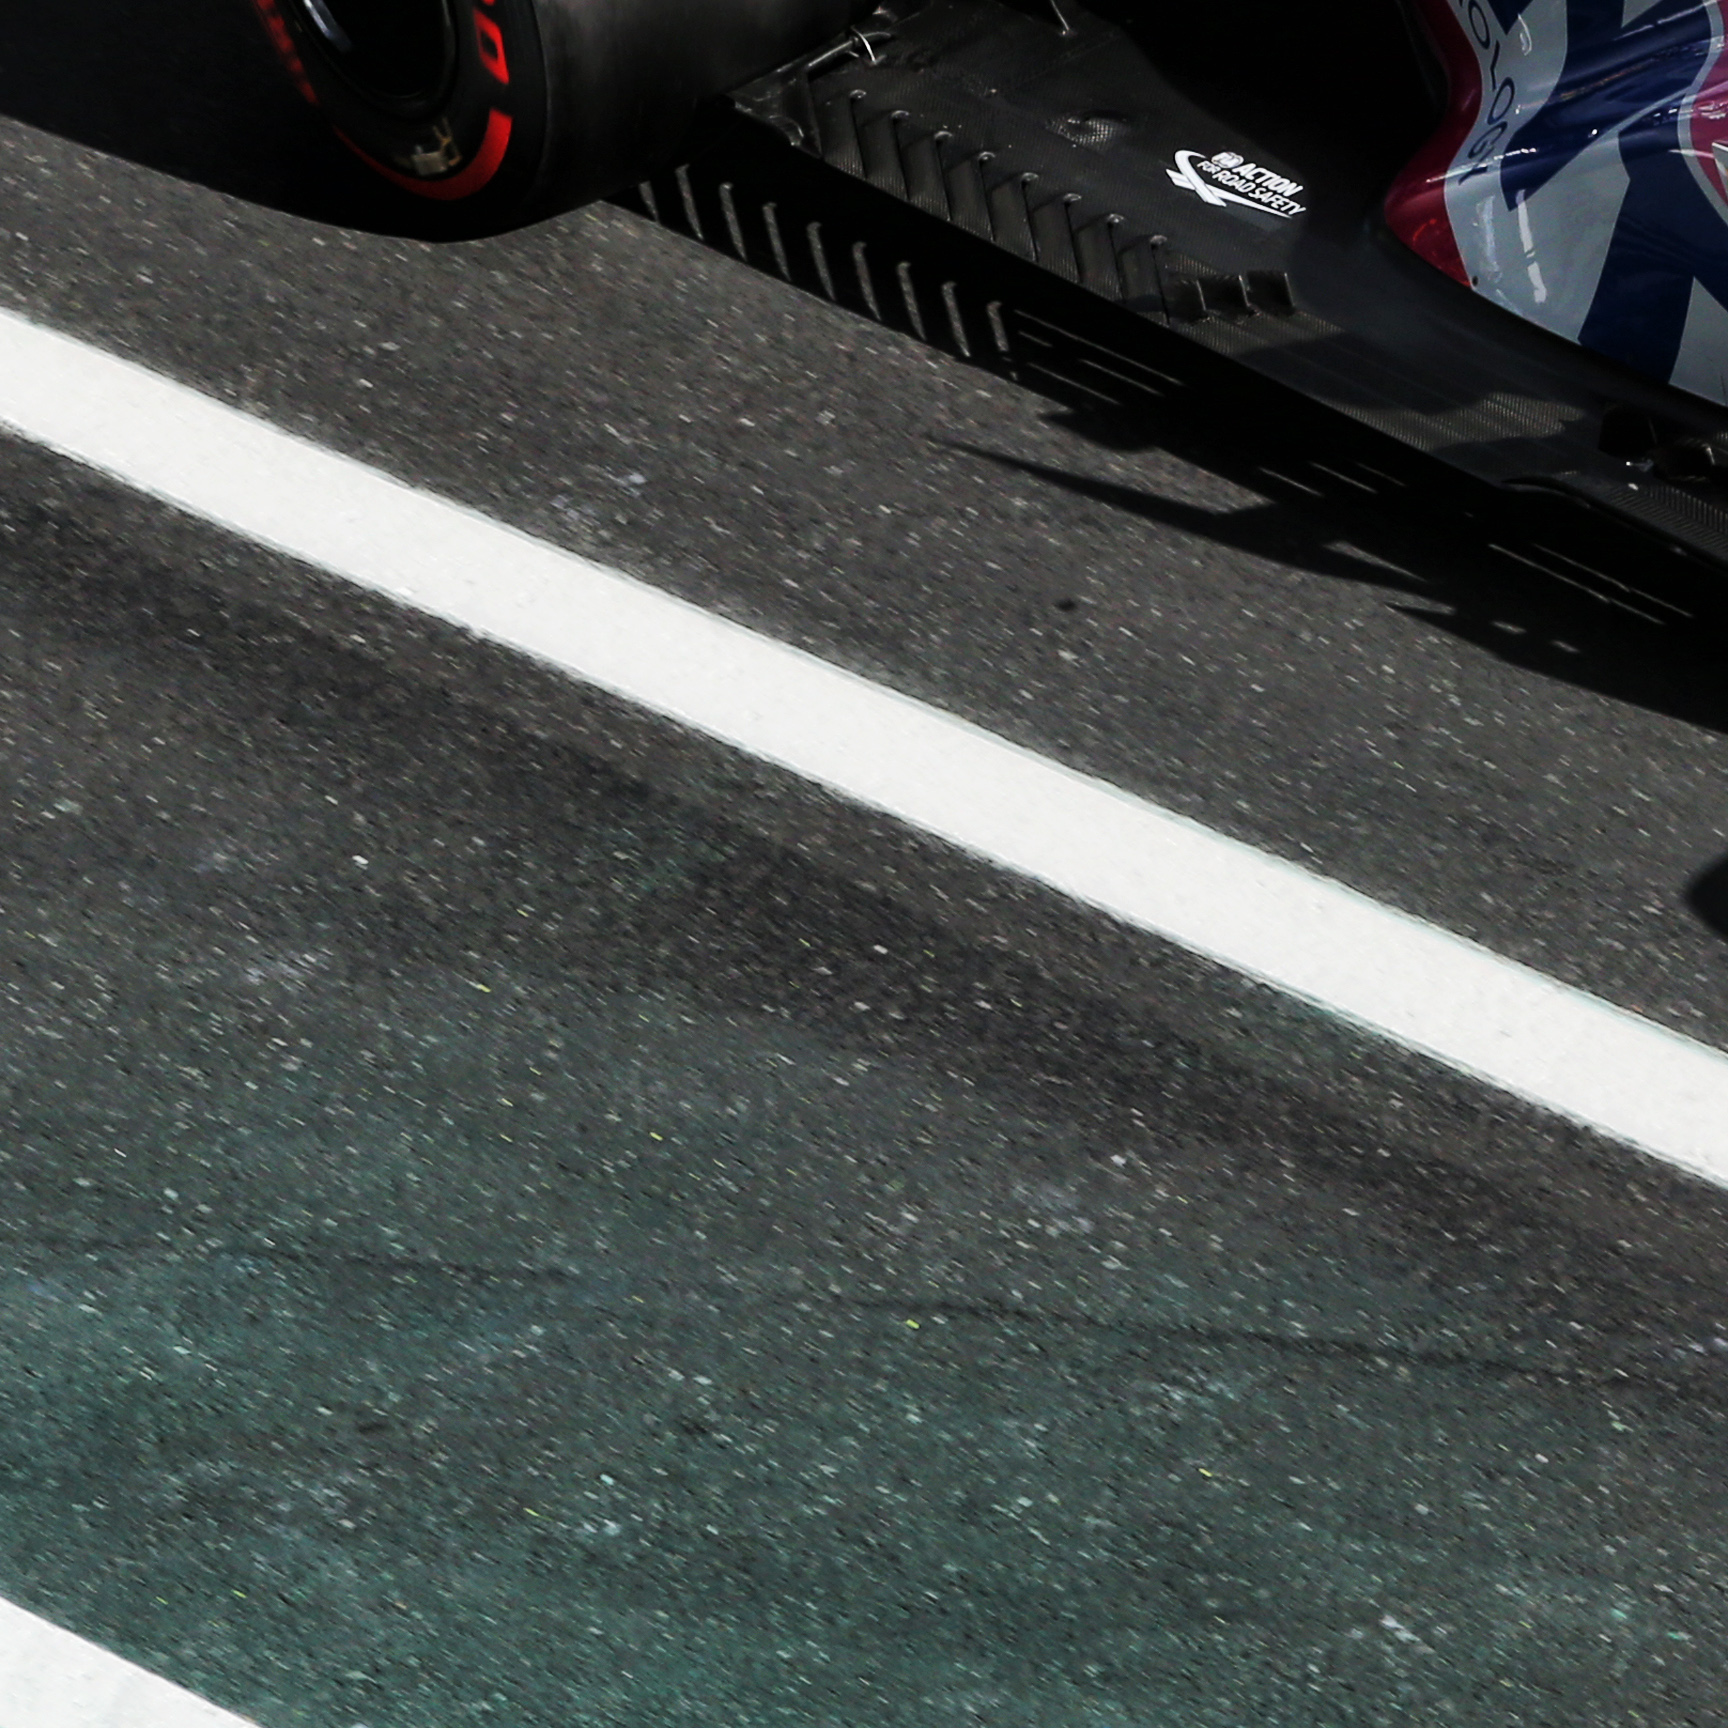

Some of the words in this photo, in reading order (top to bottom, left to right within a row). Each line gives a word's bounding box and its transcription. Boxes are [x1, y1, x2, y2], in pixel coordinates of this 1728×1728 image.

[1212, 170, 1256, 192] ROAD
[1248, 187, 1306, 215] SAFETY
[1232, 163, 1303, 197] ACTION
